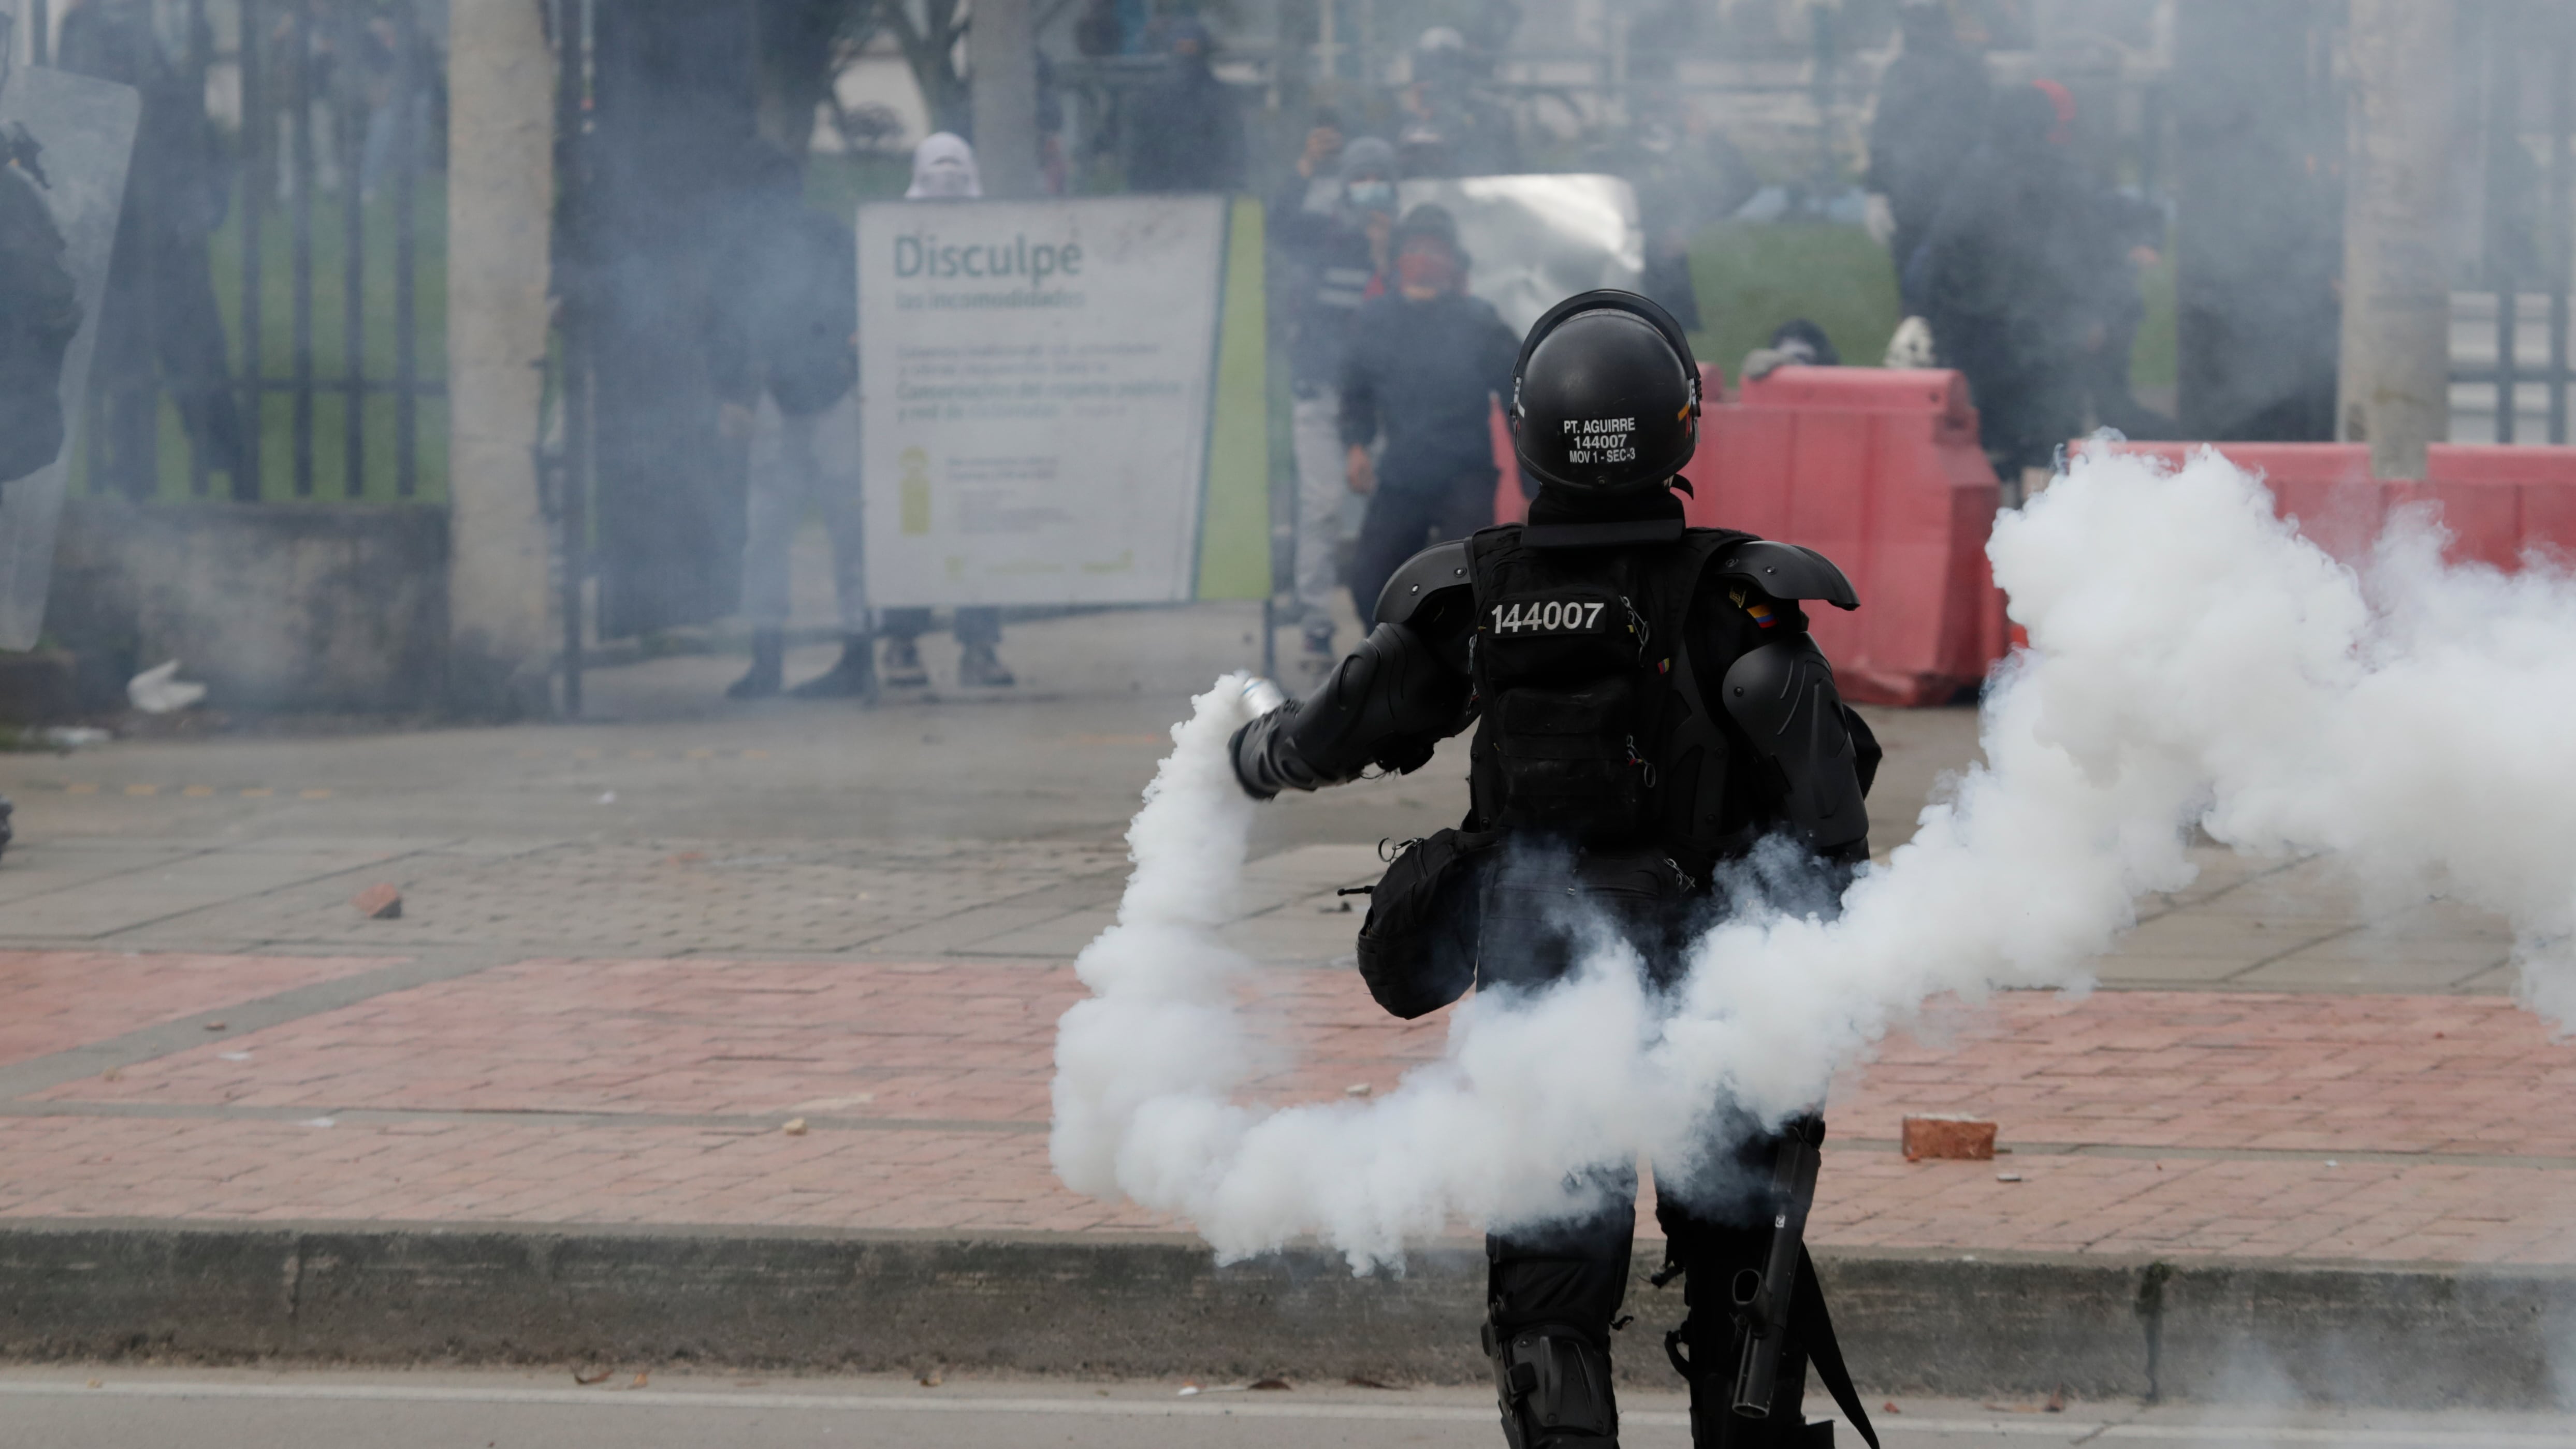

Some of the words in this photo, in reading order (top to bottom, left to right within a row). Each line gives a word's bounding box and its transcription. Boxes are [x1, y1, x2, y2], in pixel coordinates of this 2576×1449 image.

[894, 233, 1083, 288] Disculpe
[1564, 420, 1580, 433] PT.
[1583, 417, 1635, 433] AGUIRRE
[1574, 433, 1627, 449] 144007
[1569, 450, 1590, 463] MOV
[1593, 451, 1597, 463] 1
[1607, 447, 1635, 462] SEC-3
[1491, 601, 1604, 633] 144007
